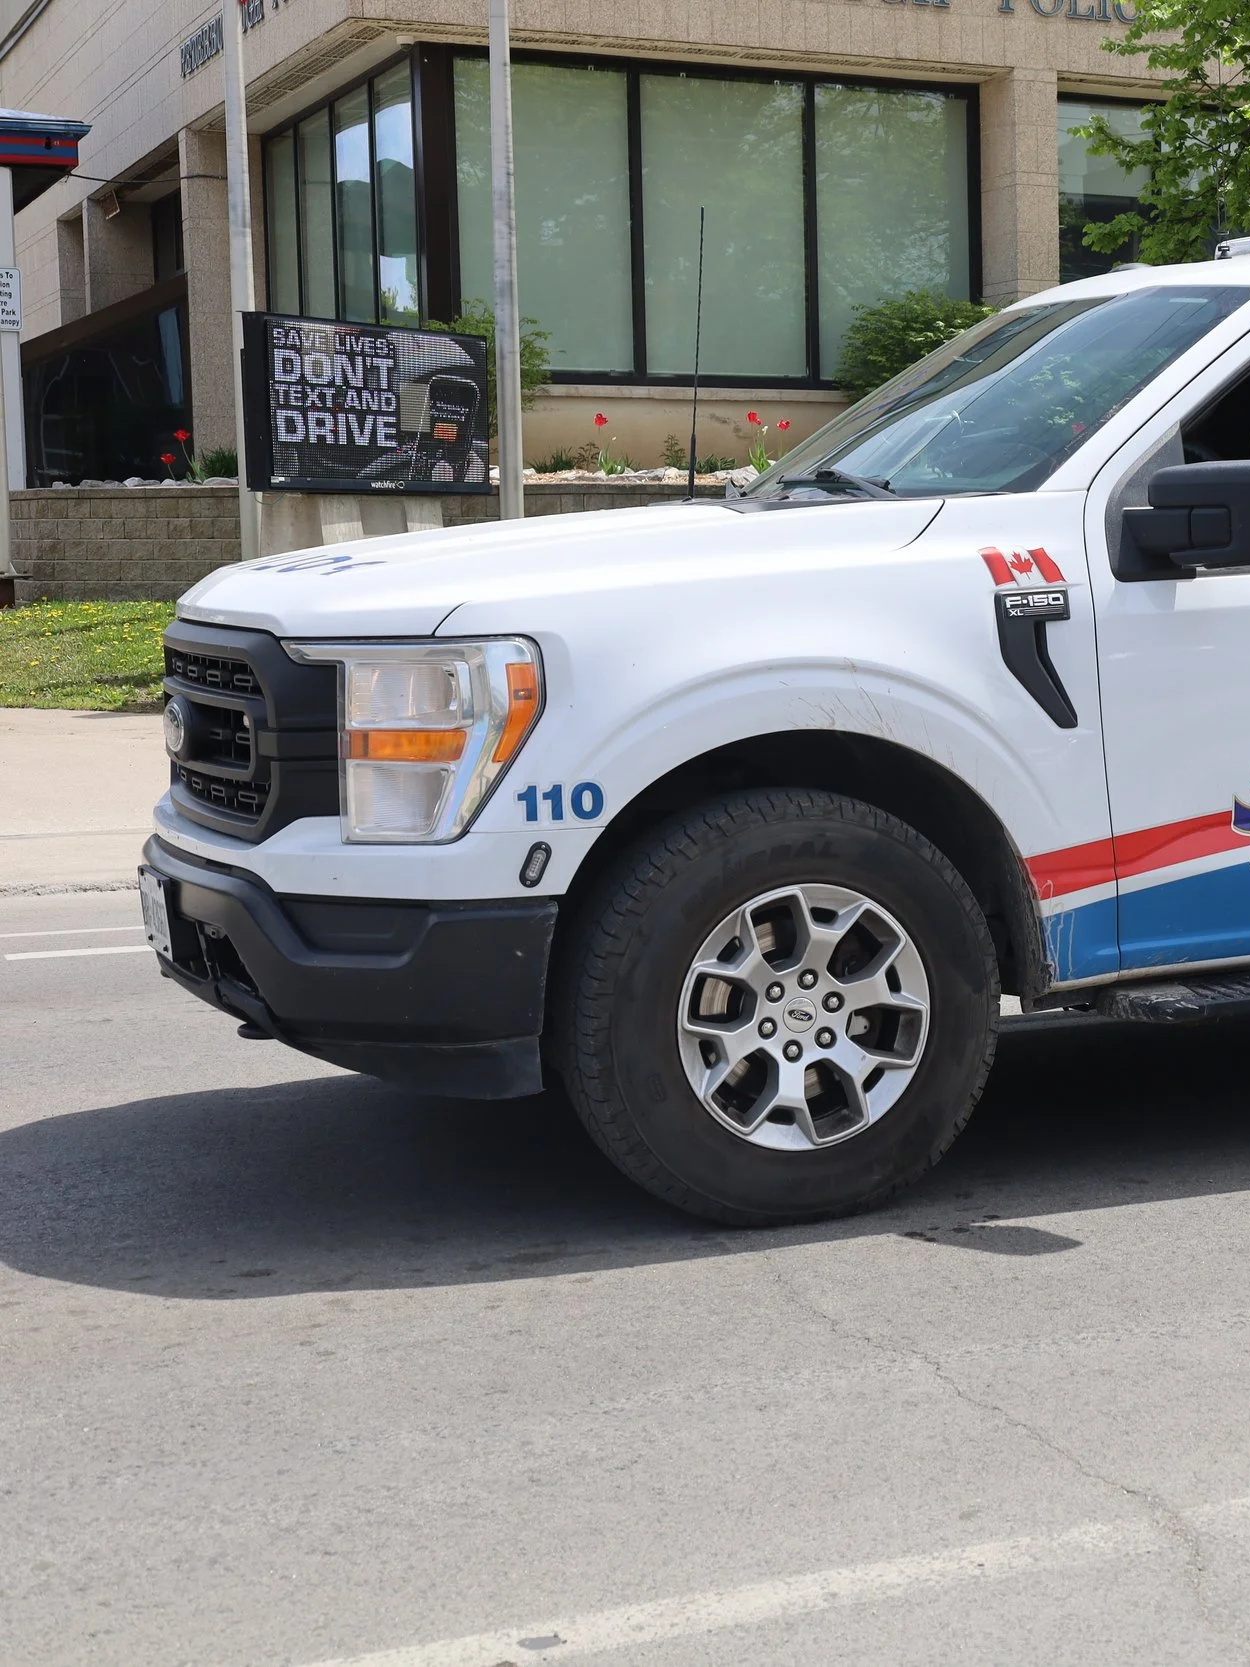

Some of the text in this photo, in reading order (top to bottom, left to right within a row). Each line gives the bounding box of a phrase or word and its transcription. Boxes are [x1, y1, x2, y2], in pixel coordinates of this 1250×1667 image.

[5, 271, 14, 279] To
[1, 308, 17, 316] Park
[273, 327, 395, 357] SAVE LIVES:
[273, 348, 395, 390] DON'T
[273, 383, 397, 412] TEXT AND
[275, 409, 398, 448] DRIVE
[370, 480, 396, 489] watchfire
[1005, 593, 1064, 609] F-150
[1009, 608, 1024, 617] XL
[516, 781, 605, 822] 110
